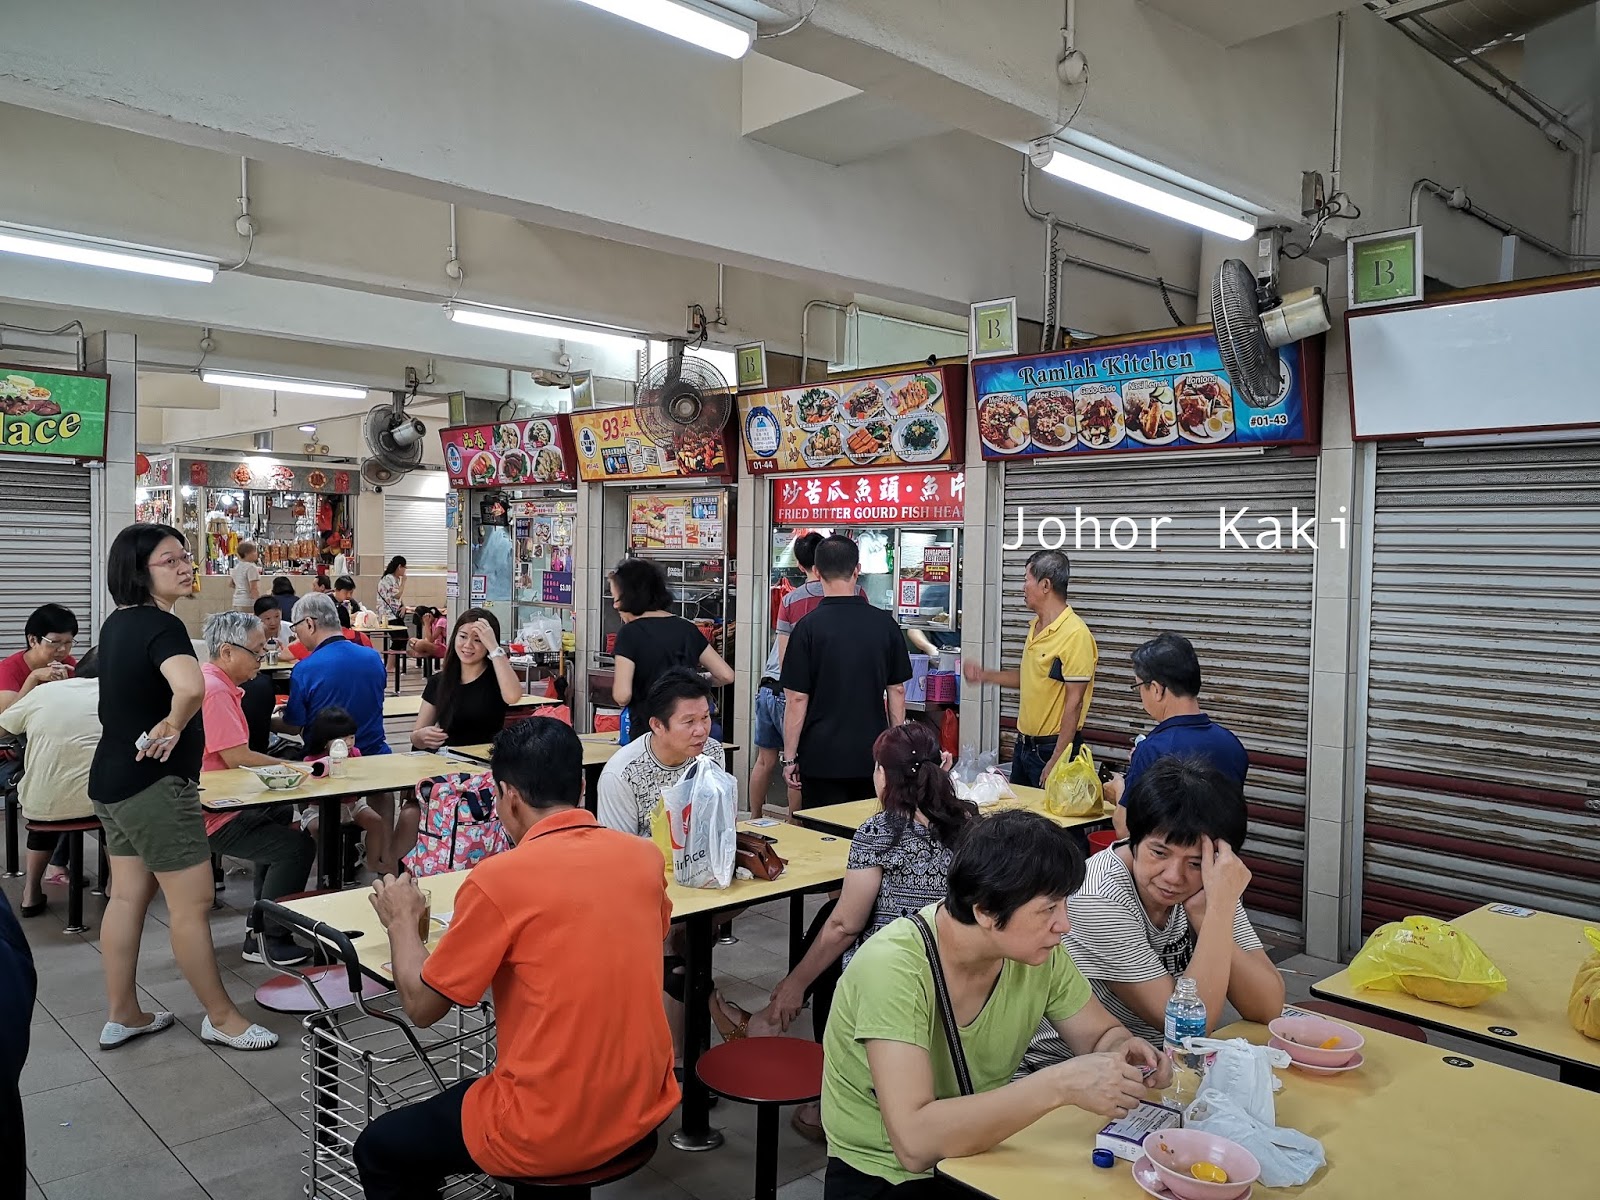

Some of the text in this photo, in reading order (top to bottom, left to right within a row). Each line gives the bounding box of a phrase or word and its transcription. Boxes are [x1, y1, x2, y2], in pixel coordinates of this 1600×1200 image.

[1373, 258, 1396, 287] B
[987, 318, 1001, 340] B
[745, 356, 755, 373] B
[1017, 349, 1194, 387] Ramlah Kitchen
[1186, 375, 1219, 385] Lontong
[602, 416, 620, 441] 93
[1250, 414, 1288, 428] #01-43
[753, 460, 773, 469] 01-44
[778, 508, 810, 520] FRIED
[812, 507, 851, 519] BITTER
[853, 506, 898, 519] GOURD
[901, 506, 929, 518] FISH
